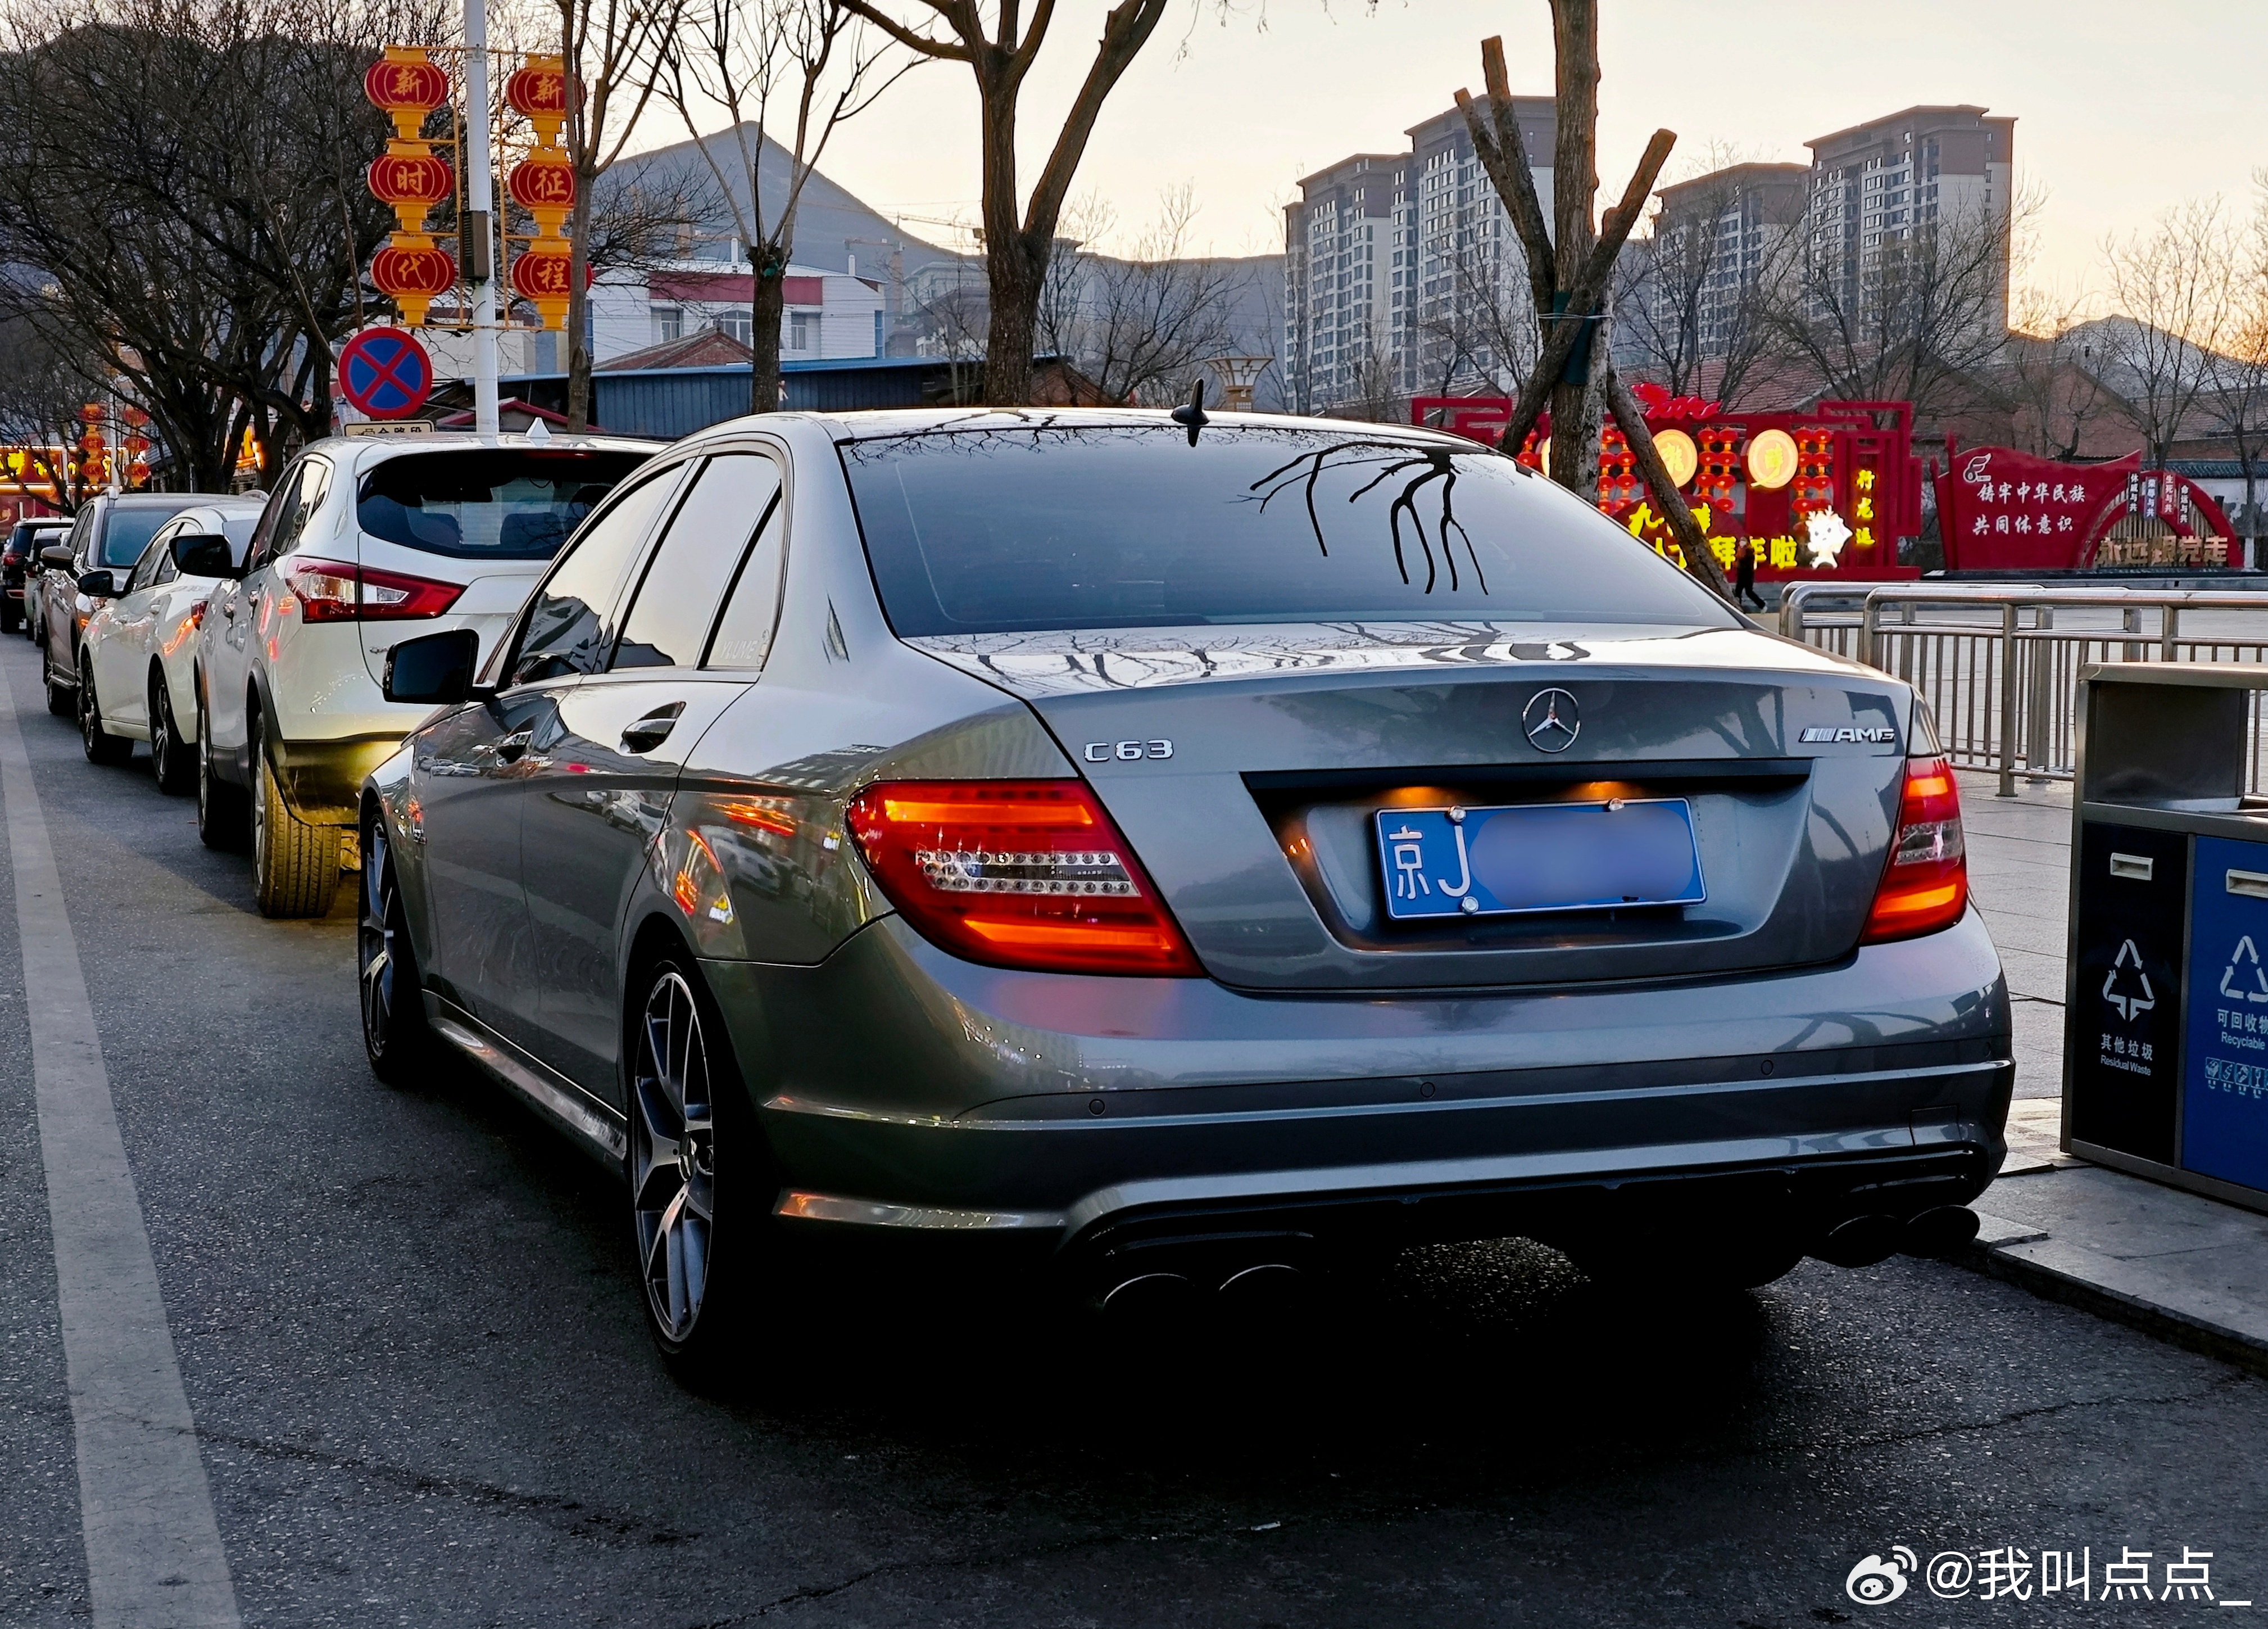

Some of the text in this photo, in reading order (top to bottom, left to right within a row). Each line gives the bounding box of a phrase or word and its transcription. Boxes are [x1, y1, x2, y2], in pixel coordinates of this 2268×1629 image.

[391, 69, 427, 289] 新时代
[531, 75, 568, 289] 新征程
[1977, 482, 2086, 504] 铸牢中华民族
[2164, 474, 2174, 513] 生死与共
[2180, 485, 2189, 523] 命运与共
[1972, 514, 2073, 535] 共同体意识
[2096, 535, 2228, 565] 永远跟党走
[1833, 727, 1895, 743] AMG
[2217, 1008, 2268, 1035] 可回收物
[2101, 1033, 2152, 1061] 其他垃圾
[2221, 1031, 2265, 1050] Recyclable
[2101, 1055, 2151, 1076] Residual Waste
